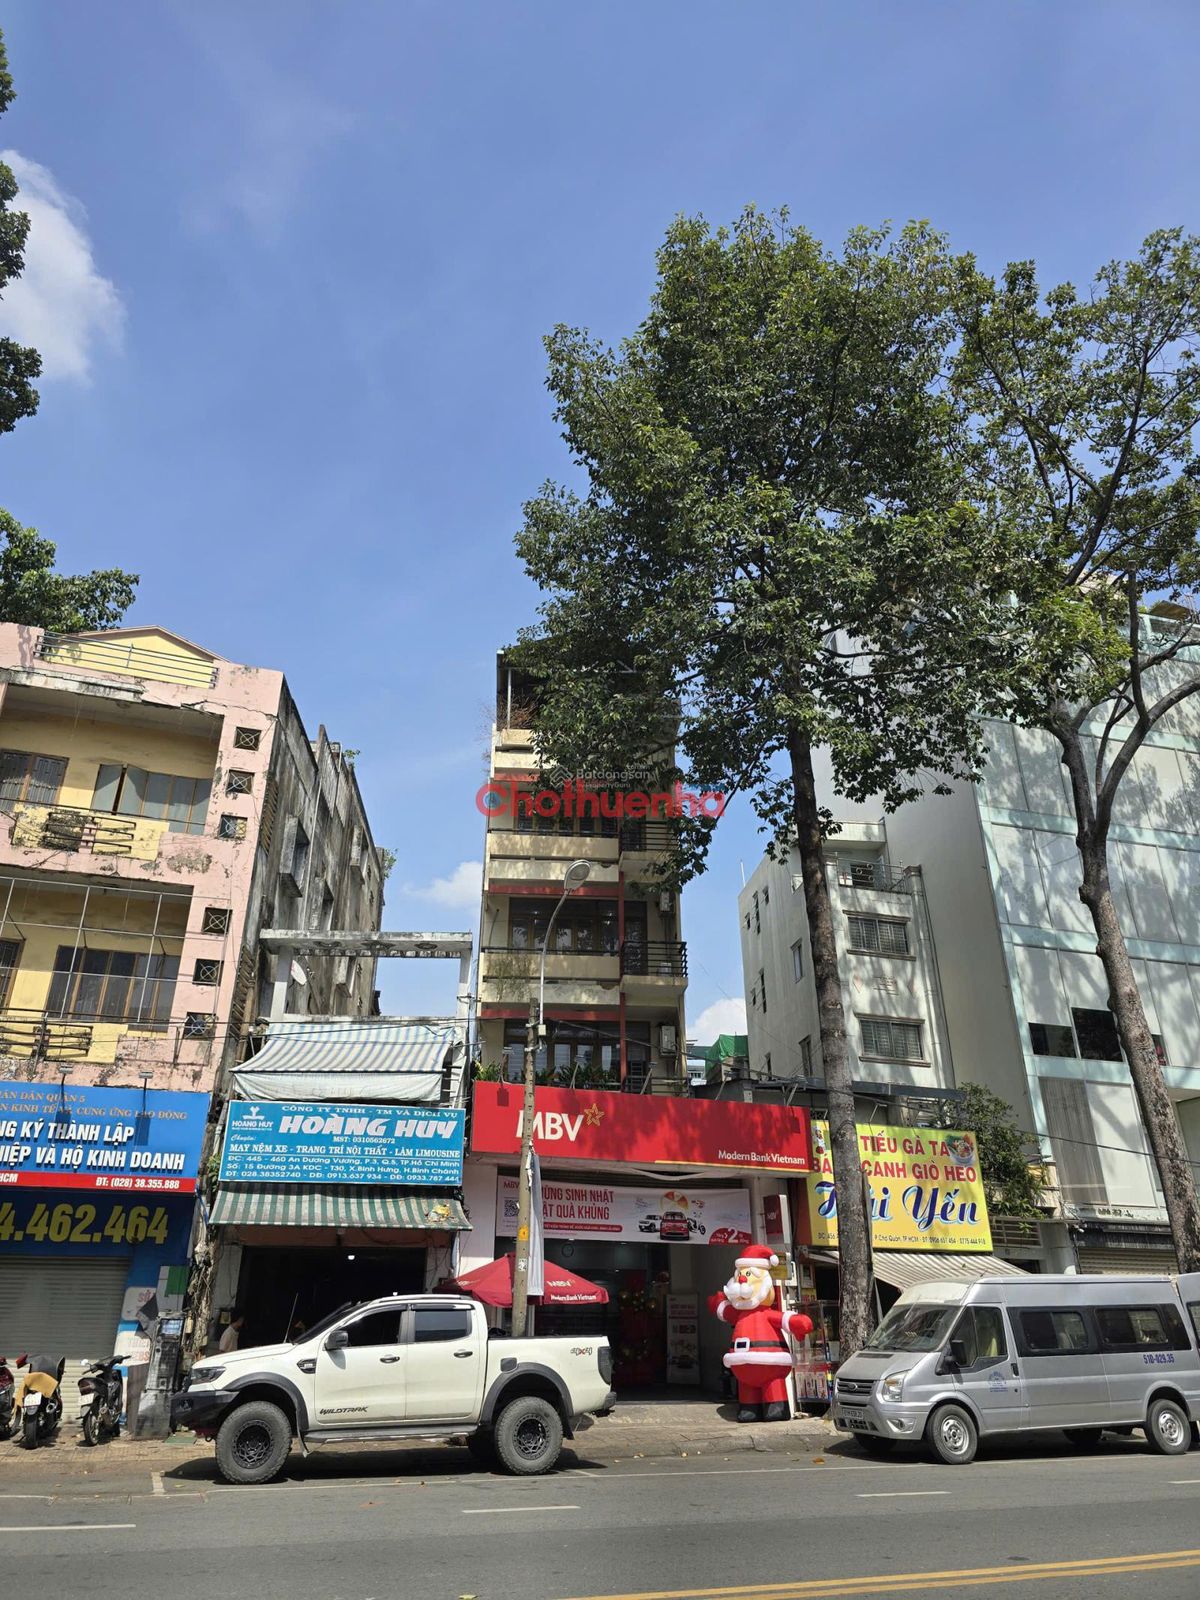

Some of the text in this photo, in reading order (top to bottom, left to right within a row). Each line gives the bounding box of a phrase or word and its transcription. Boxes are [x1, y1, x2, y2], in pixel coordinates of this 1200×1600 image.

[335, 1107, 366, 1115] TNHH
[20, 1118, 44, 1139] KÝ
[48, 1120, 100, 1142] THÀNH
[103, 1122, 135, 1146] LẬP
[279, 1113, 458, 1139] HOÀNG HUY
[229, 1143, 251, 1152] MAY
[252, 1142, 272, 1154] NỆM
[274, 1145, 288, 1153] XE
[296, 1145, 326, 1154] TRANG
[329, 1145, 344, 1154] TRÍ
[346, 1145, 361, 1156] NỘI
[364, 1144, 387, 1155] THẤT
[395, 1147, 413, 1156] LÀM
[416, 1150, 460, 1158] LIMOUSINE
[860, 1131, 950, 1157] TIẾU GÀ TA
[35, 1144, 57, 1164] VÀ
[60, 1145, 83, 1170] HỘ
[86, 1150, 126, 1167] KINH
[130, 1151, 185, 1170] DOANH
[861, 1160, 907, 1179] CANH
[912, 1160, 940, 1181] GIÒ
[944, 1165, 977, 1183] HEO
[111, 1178, 133, 1189] (028)
[565, 1188, 588, 1202] SINH
[589, 1189, 614, 1206] NHẬT
[556, 1202, 576, 1219] QUÀ
[902, 1185, 981, 1232] Yến
[727, 1227, 738, 1243] 2
[319, 1405, 369, 1416] WILDTRAK
